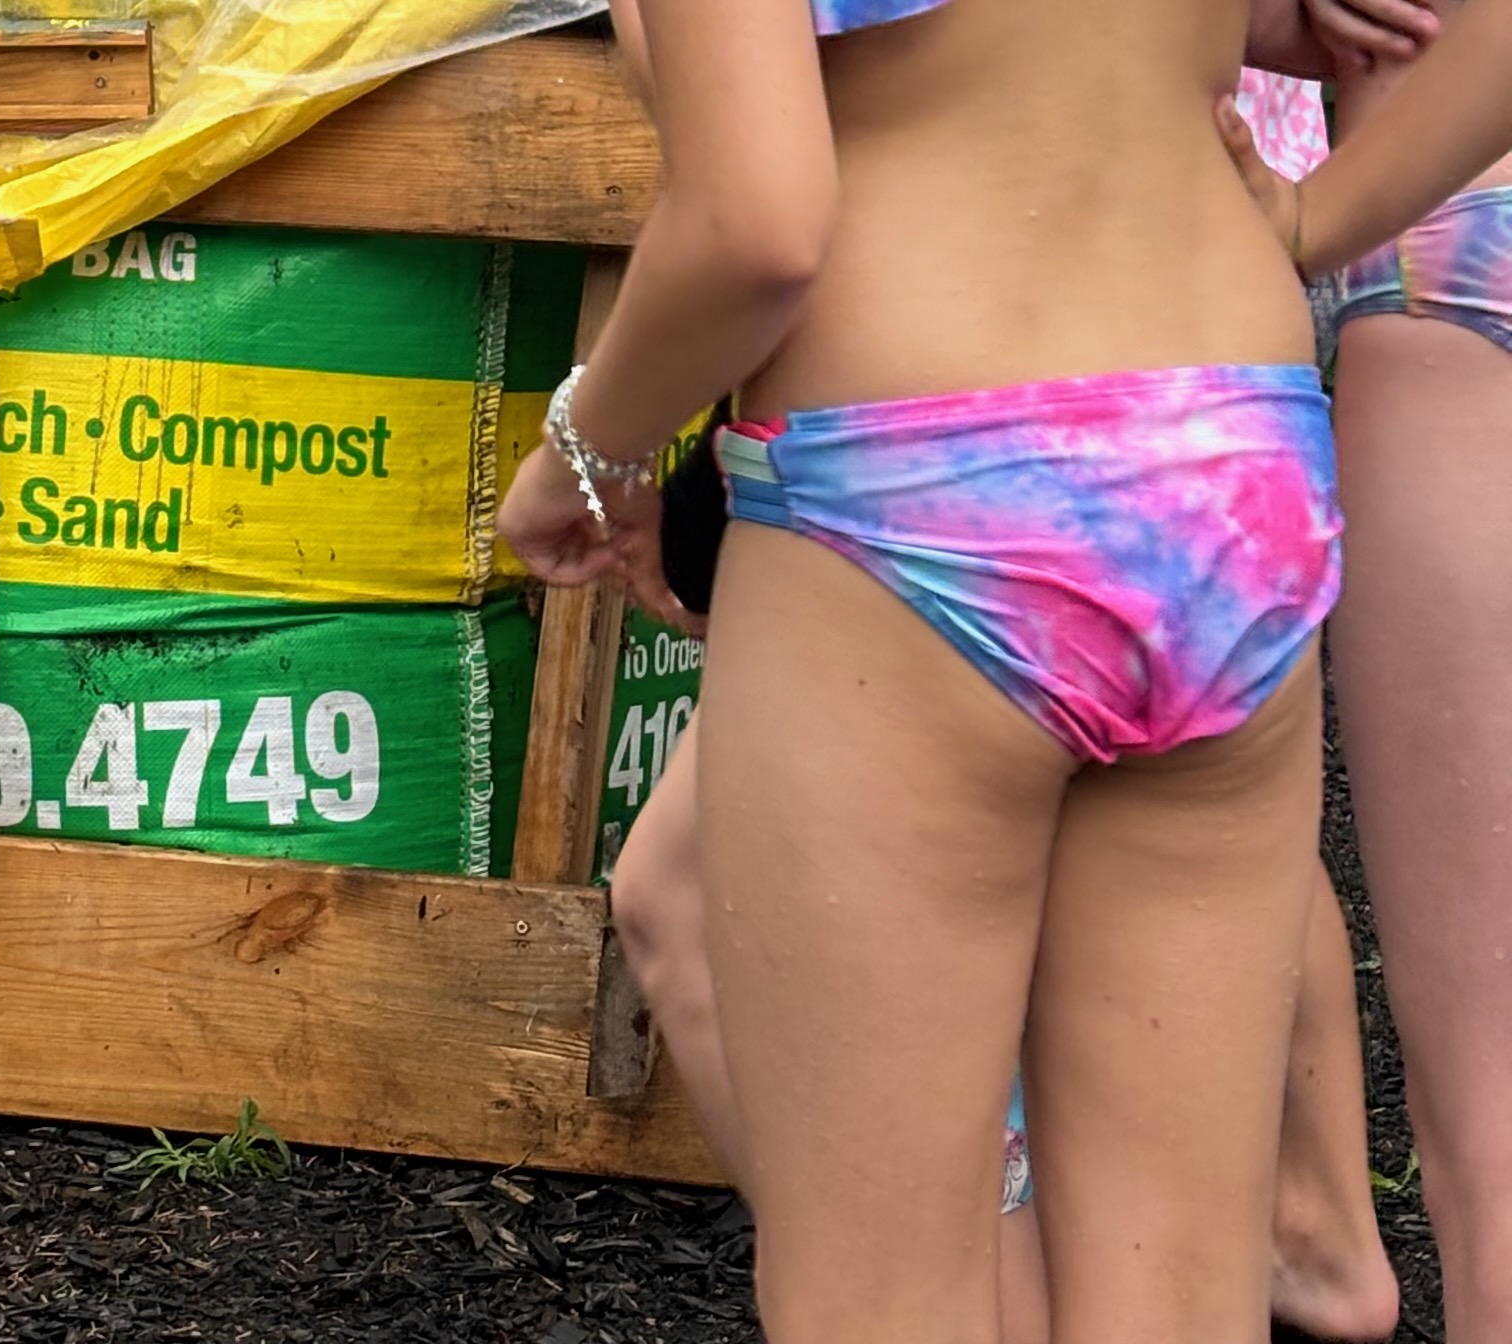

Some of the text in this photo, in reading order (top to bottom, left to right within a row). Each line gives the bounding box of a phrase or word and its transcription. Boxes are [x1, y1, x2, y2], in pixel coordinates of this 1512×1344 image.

[72, 231, 197, 282] BAG
[118, 395, 392, 485] Compost
[17, 476, 184, 553] Sand
